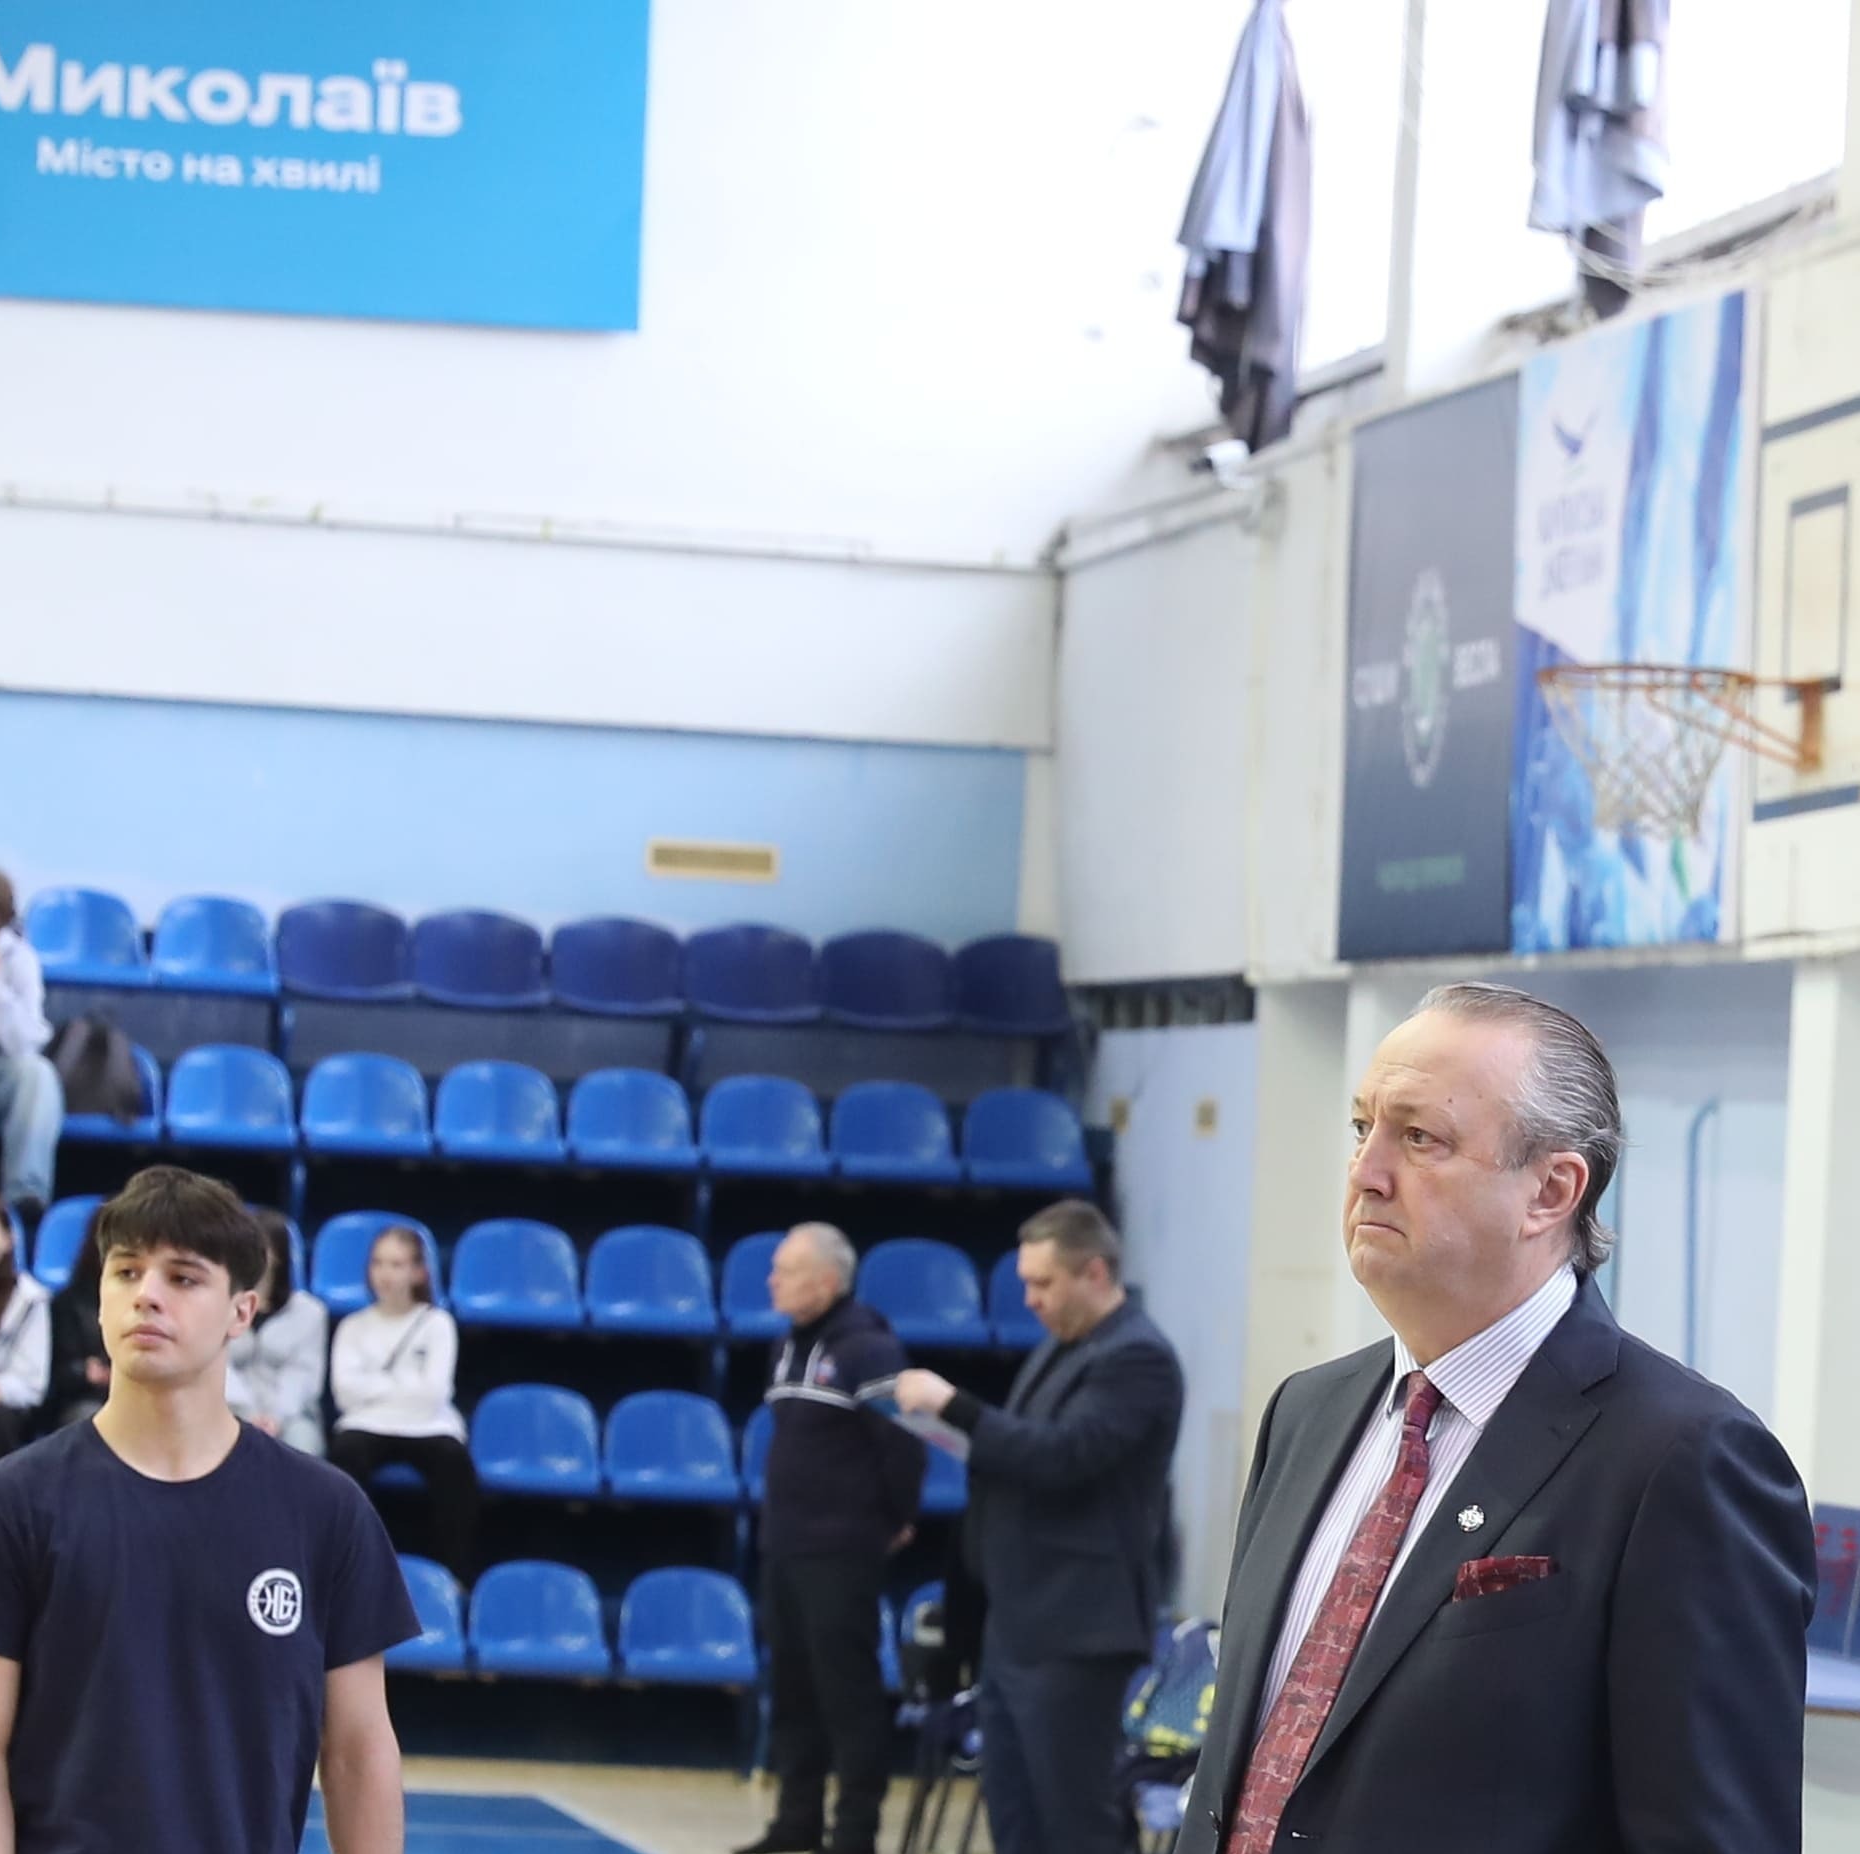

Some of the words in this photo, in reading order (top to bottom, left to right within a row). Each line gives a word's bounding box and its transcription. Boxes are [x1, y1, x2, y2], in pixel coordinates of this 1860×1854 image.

[36, 136, 174, 182] Місто
[181, 151, 244, 187] на
[250, 154, 381, 194] хвилі
